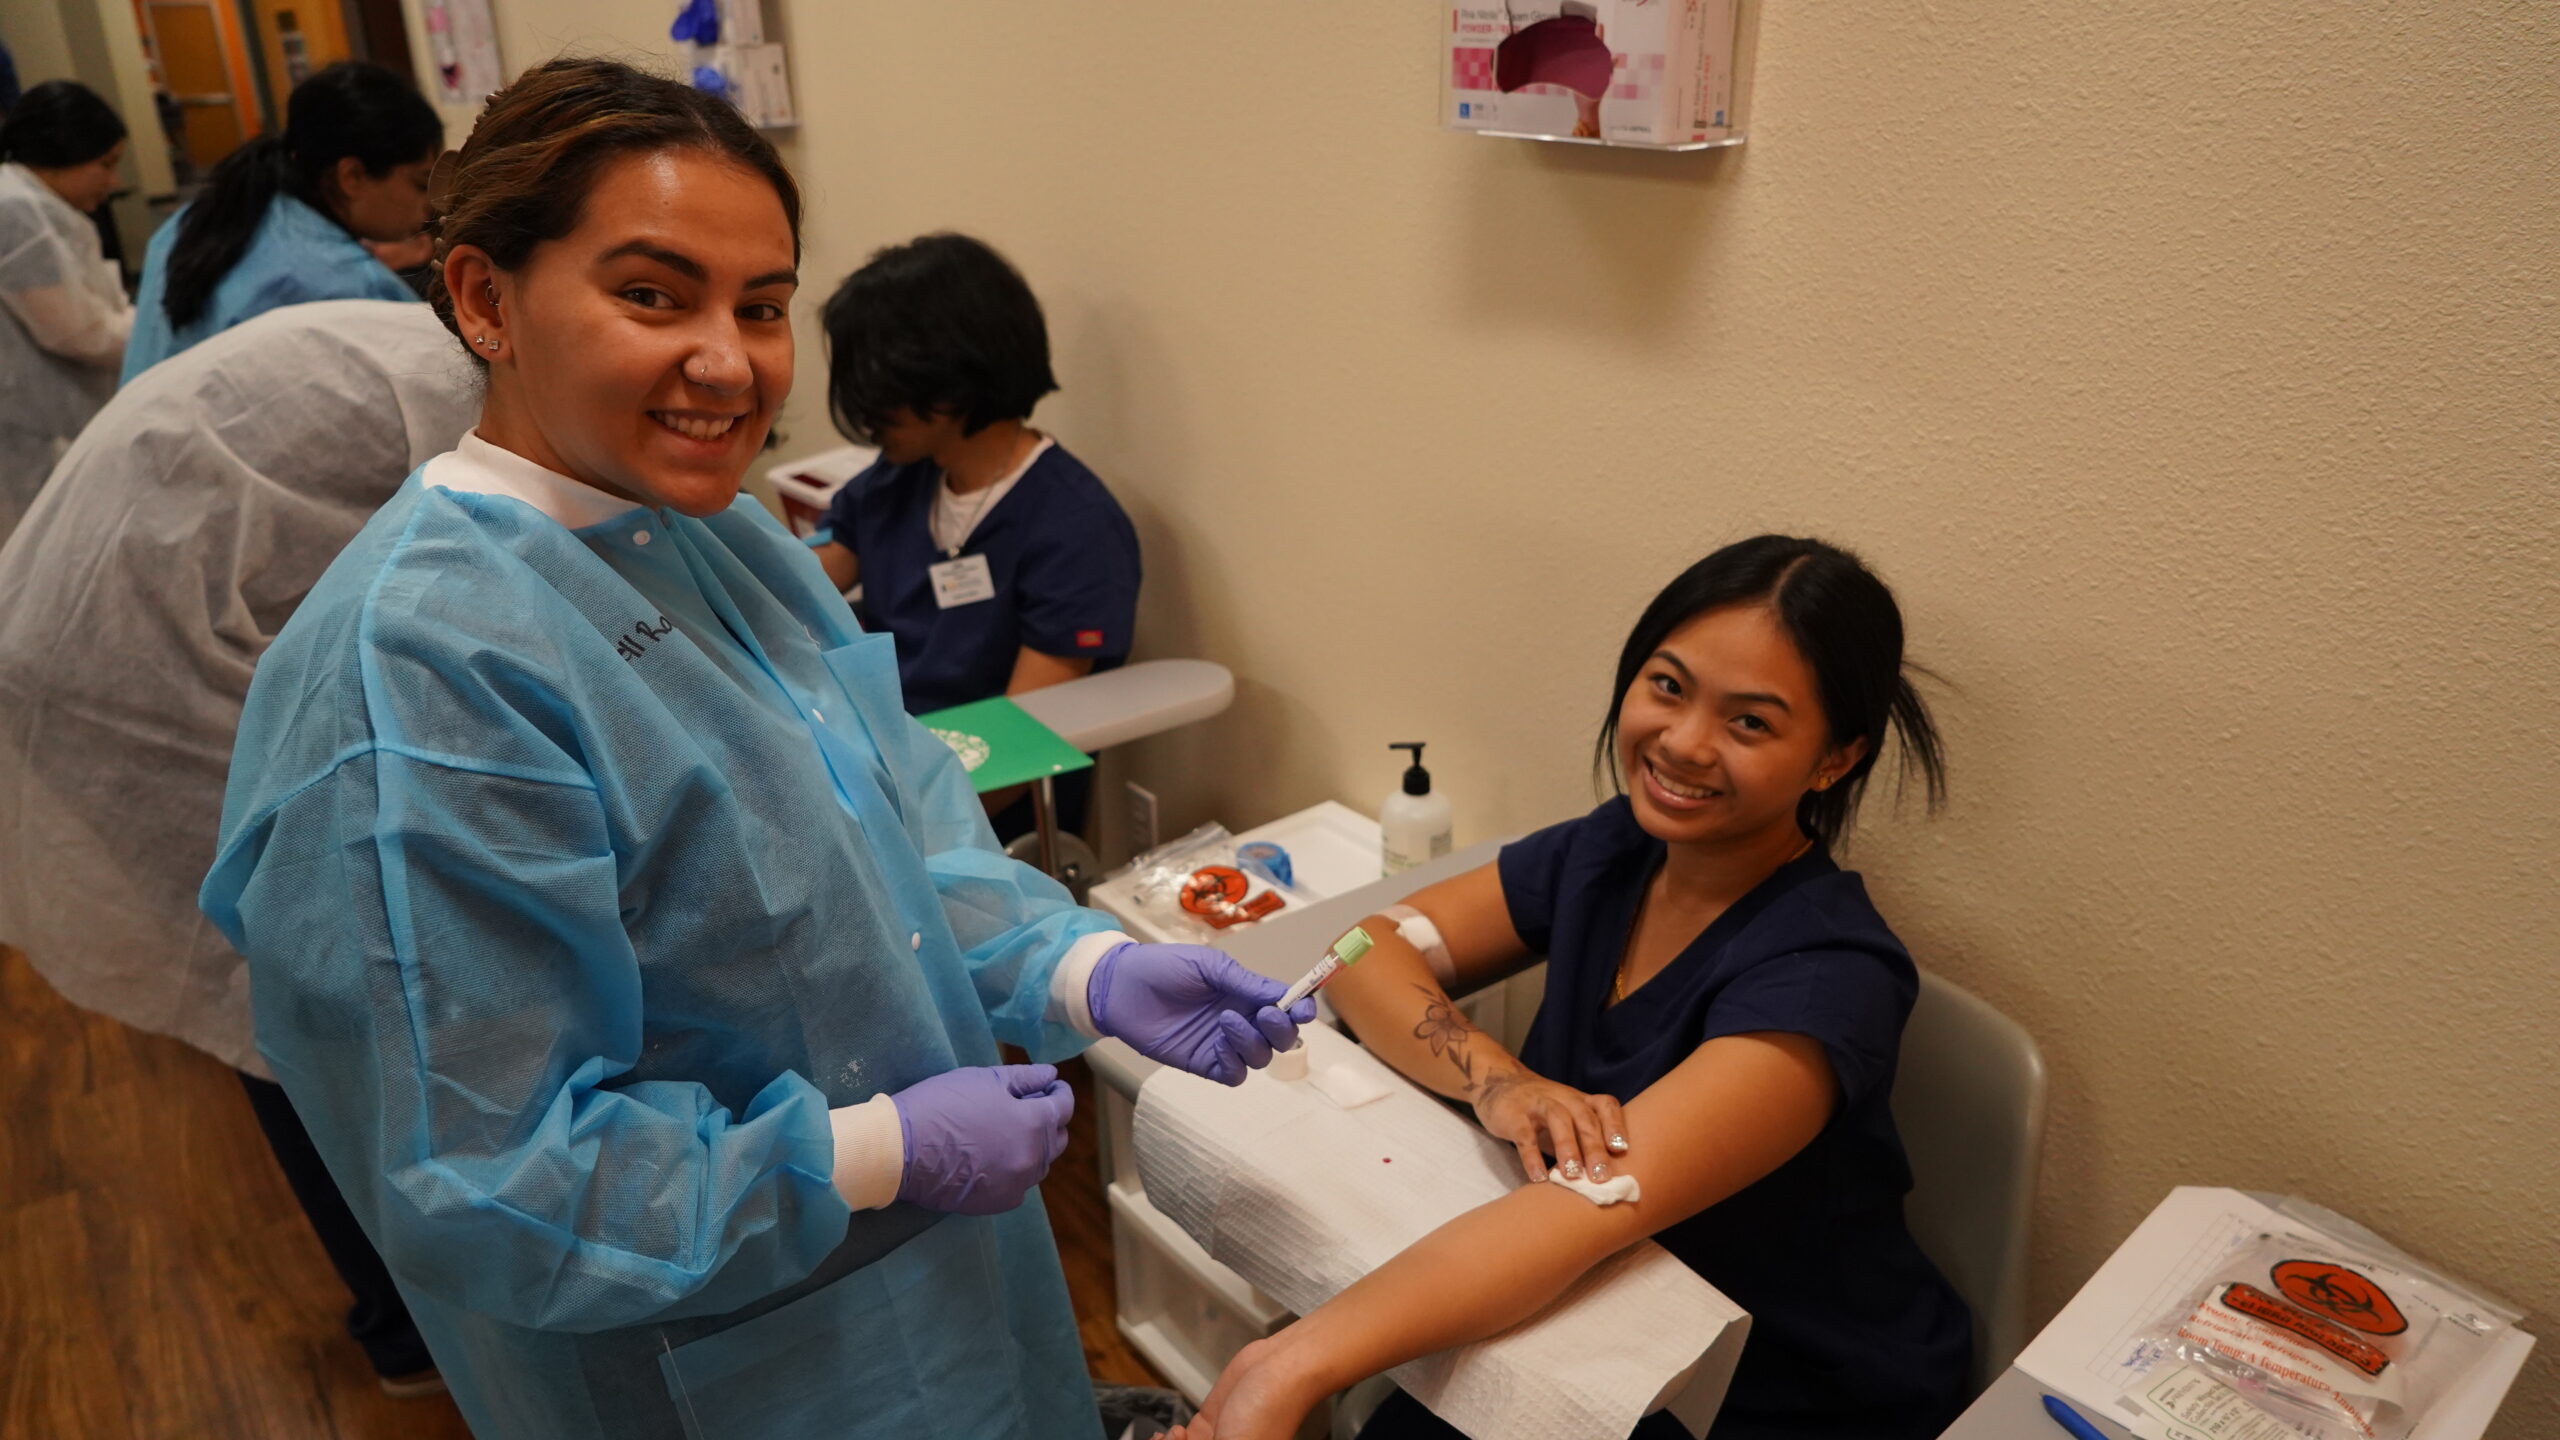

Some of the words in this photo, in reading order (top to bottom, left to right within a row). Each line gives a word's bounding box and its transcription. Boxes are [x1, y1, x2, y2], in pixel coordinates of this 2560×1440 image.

[2177, 1327, 2209, 1347] Room
[2212, 1339, 2245, 1360] Temp:
[2247, 1353, 2257, 1364] A
[2260, 1356, 2331, 1392] Temperatura
